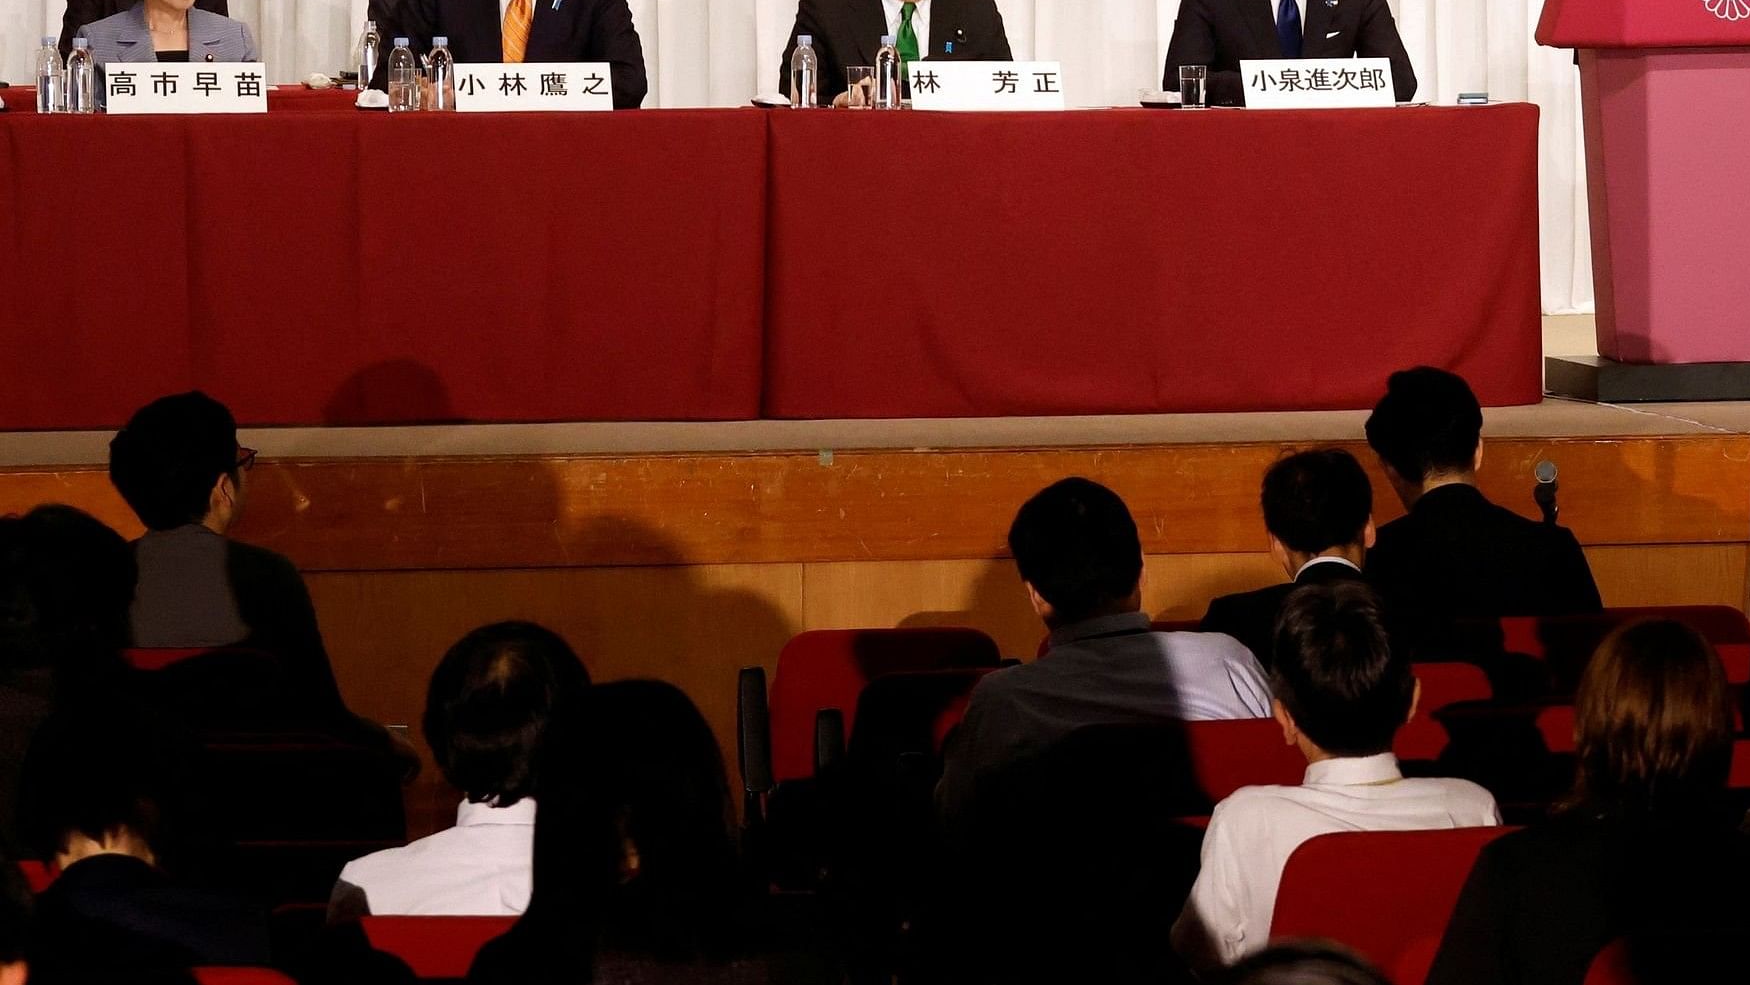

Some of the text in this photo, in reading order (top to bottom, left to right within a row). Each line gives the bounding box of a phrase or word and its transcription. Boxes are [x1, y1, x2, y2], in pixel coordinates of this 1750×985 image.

[108, 71, 262, 97] 高市早苗
[457, 71, 609, 96] 小林鷹之
[1251, 67, 1387, 92] 小泉進次郎
